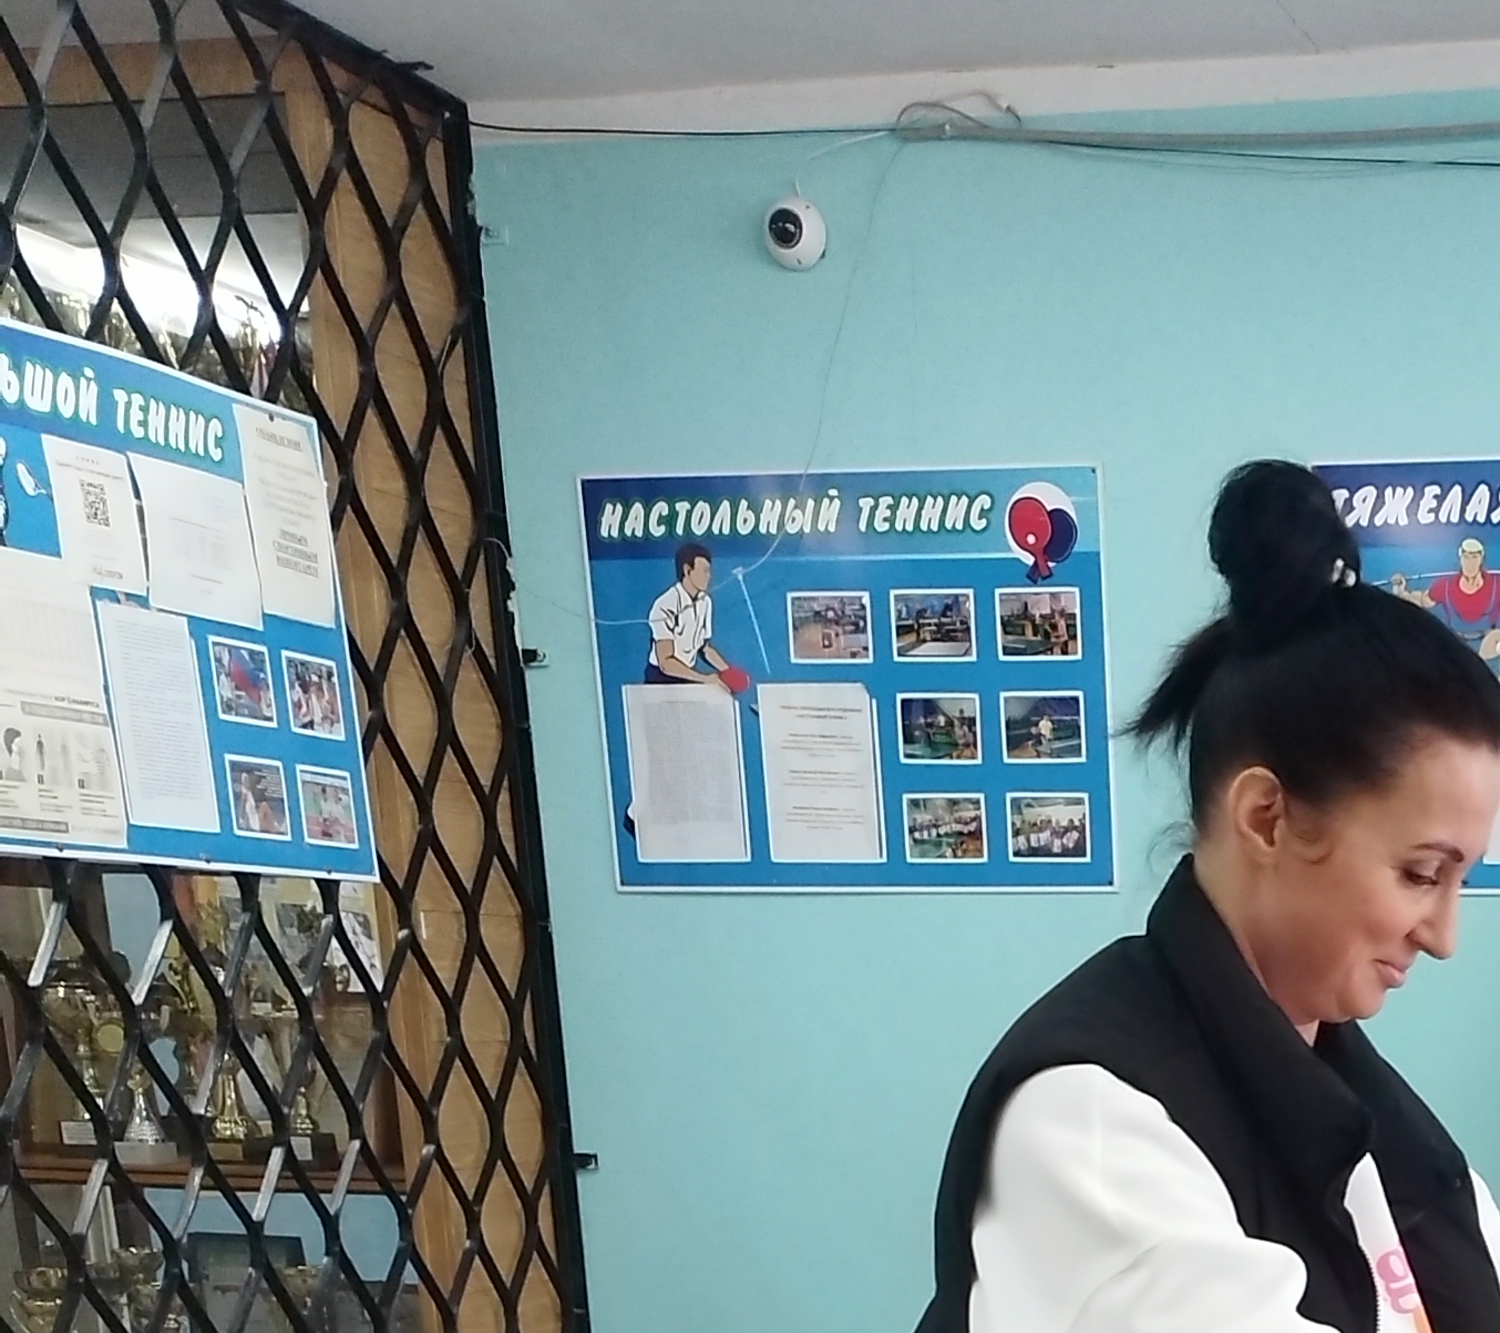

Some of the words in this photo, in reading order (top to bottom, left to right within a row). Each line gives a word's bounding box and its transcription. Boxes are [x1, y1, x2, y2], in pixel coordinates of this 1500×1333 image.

[113, 388, 223, 462] ТЕННИС
[601, 488, 841, 539] НАСТОЛЬНЫЙ
[858, 493, 992, 533] ТЕННИС
